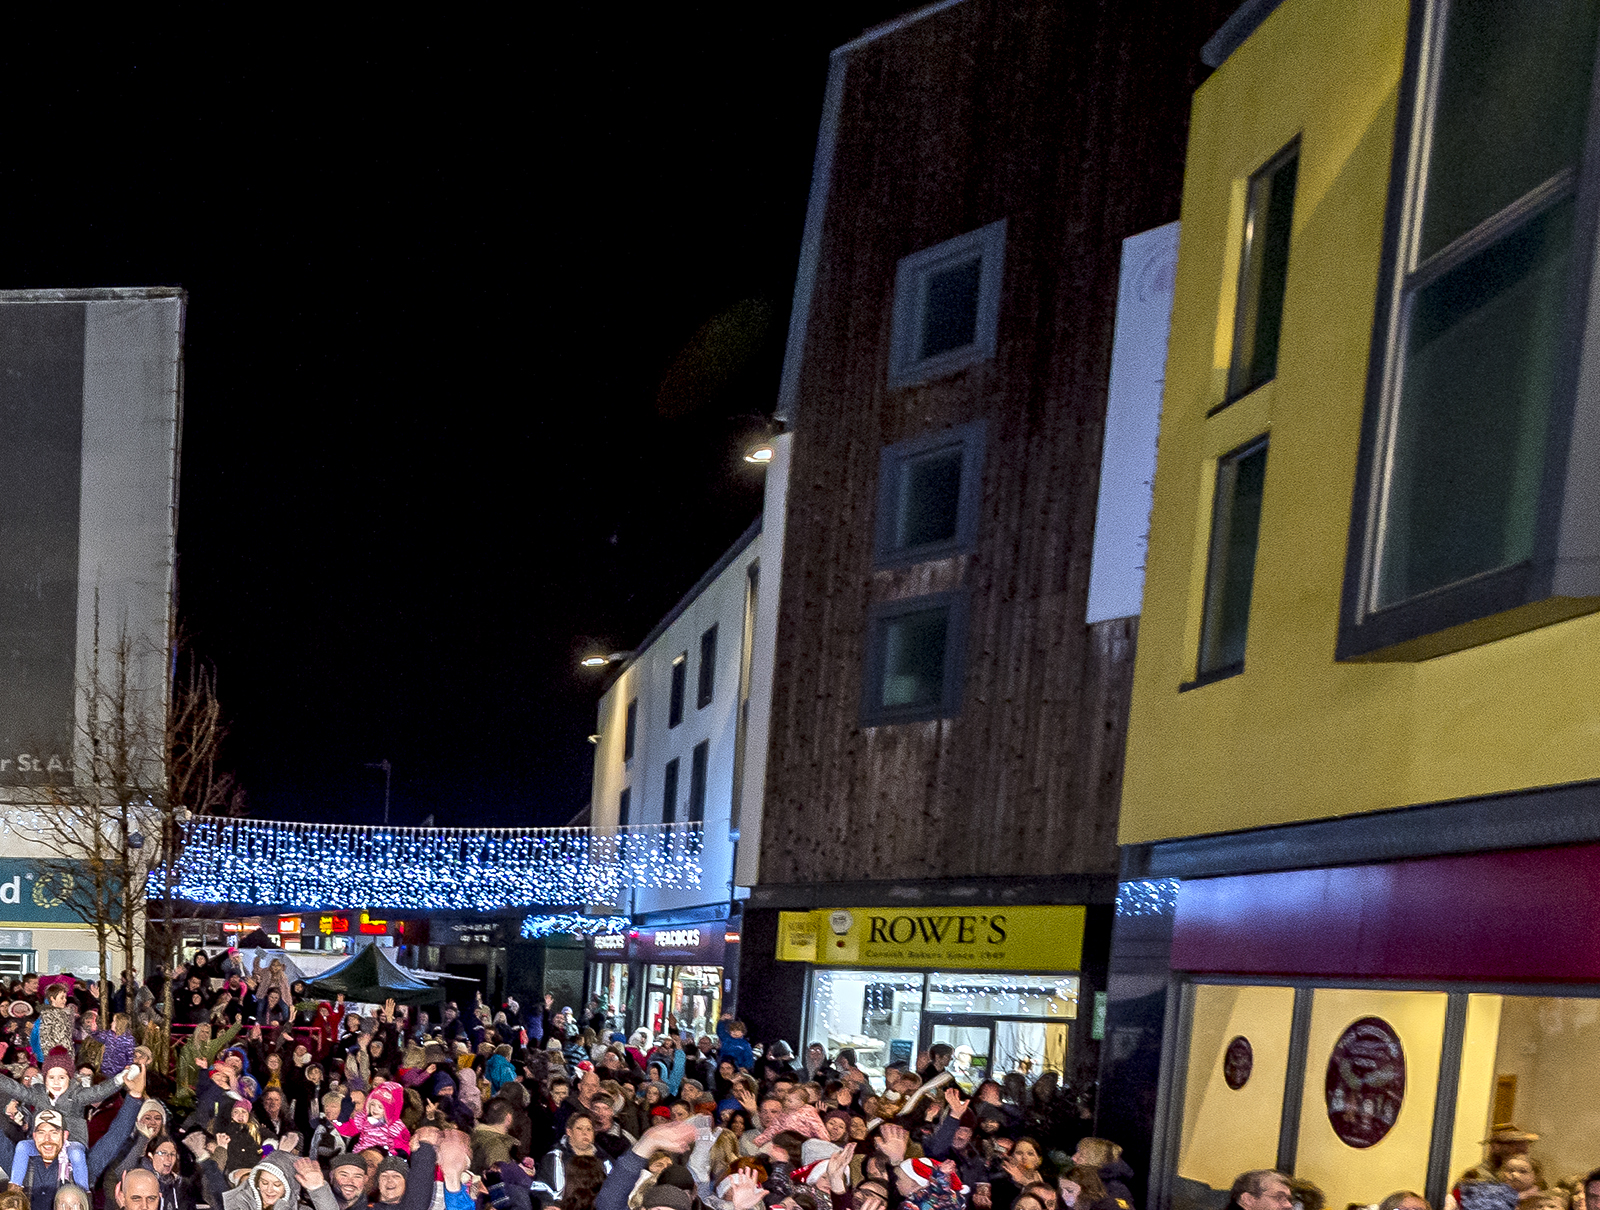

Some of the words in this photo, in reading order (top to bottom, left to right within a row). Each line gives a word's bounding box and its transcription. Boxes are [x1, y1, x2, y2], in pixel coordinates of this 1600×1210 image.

[17, 753, 43, 772] St
[653, 928, 701, 947] PEACOCKS
[868, 914, 1008, 945] ROWE'S
